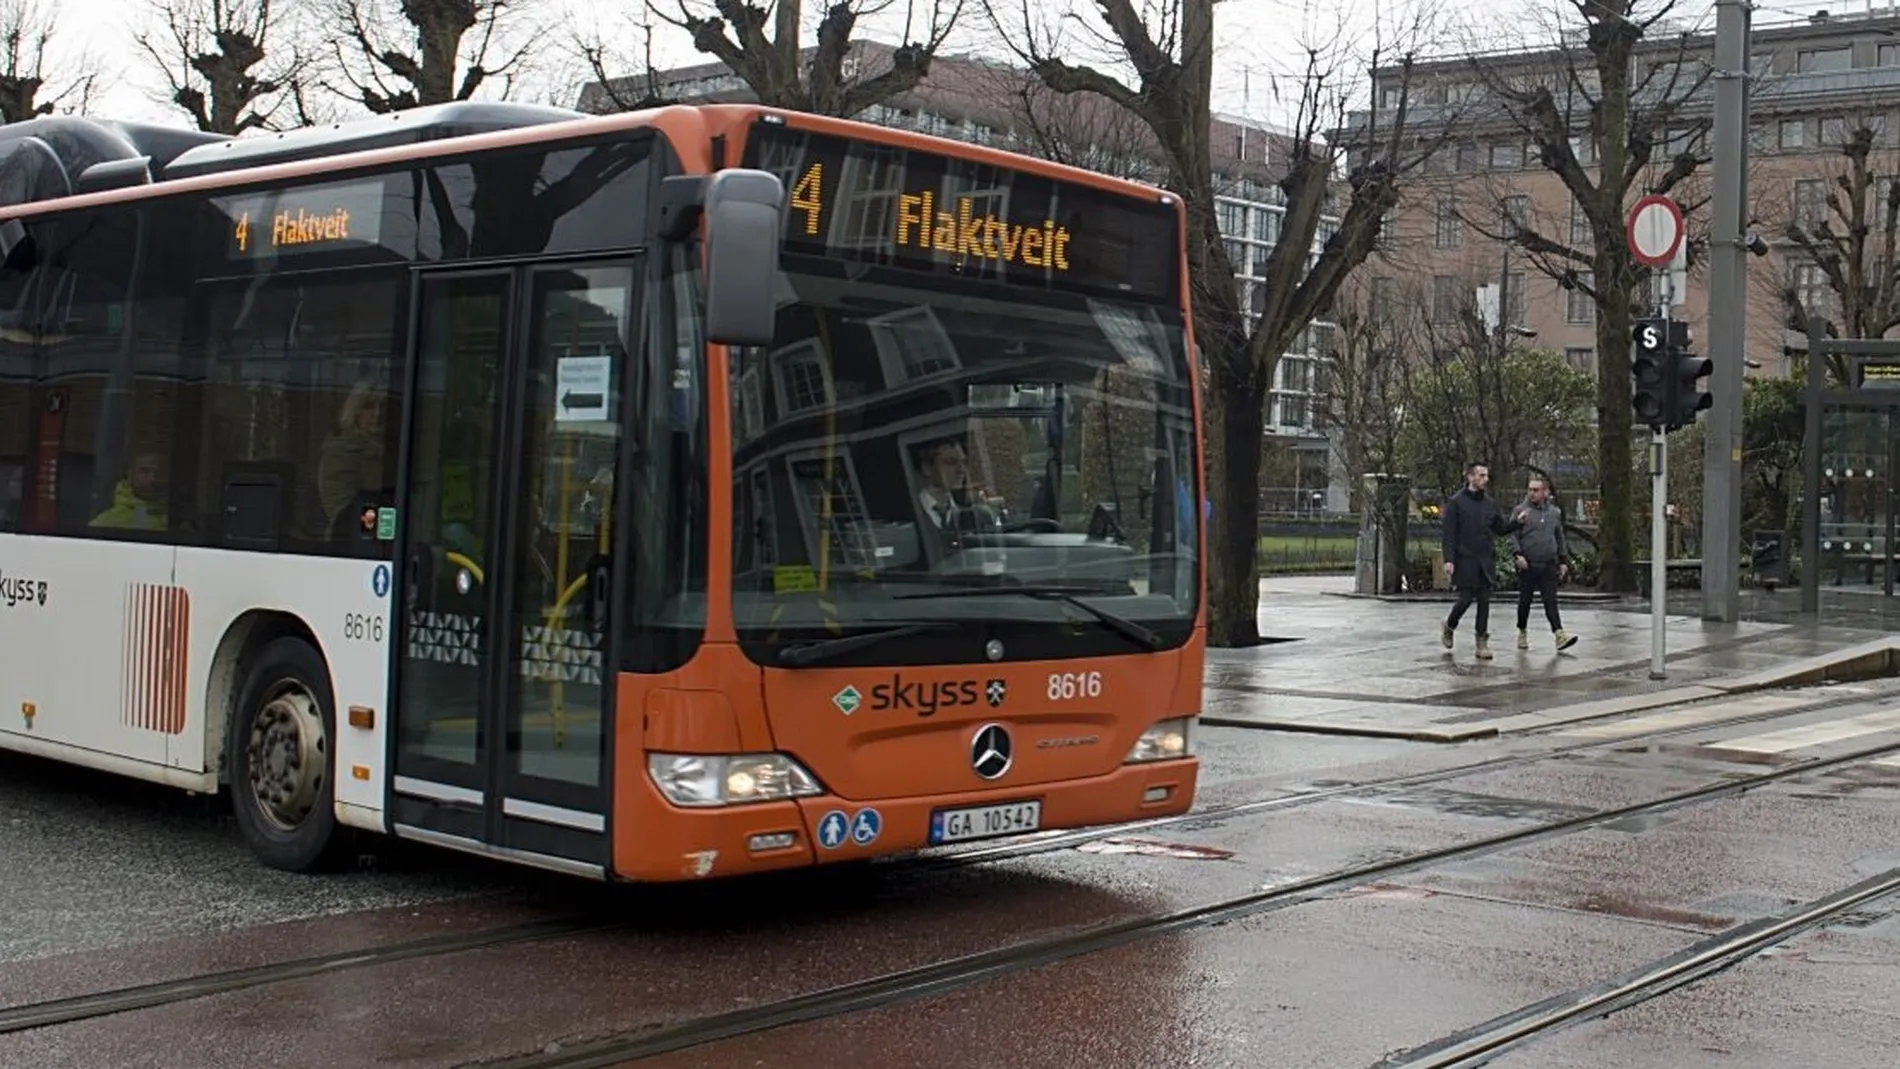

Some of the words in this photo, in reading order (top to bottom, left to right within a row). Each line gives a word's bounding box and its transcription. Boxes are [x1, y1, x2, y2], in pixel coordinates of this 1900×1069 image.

[236, 211, 247, 251] 4
[272, 208, 348, 246] Flaktveit
[791, 163, 822, 235] 4
[898, 190, 1070, 270] Flaktveit
[1643, 327, 1657, 349] S
[344, 612, 383, 642] 8616
[871, 673, 977, 716] skyss
[1047, 671, 1102, 700] 8616
[948, 813, 974, 836] GA
[983, 805, 1034, 832] 10542
